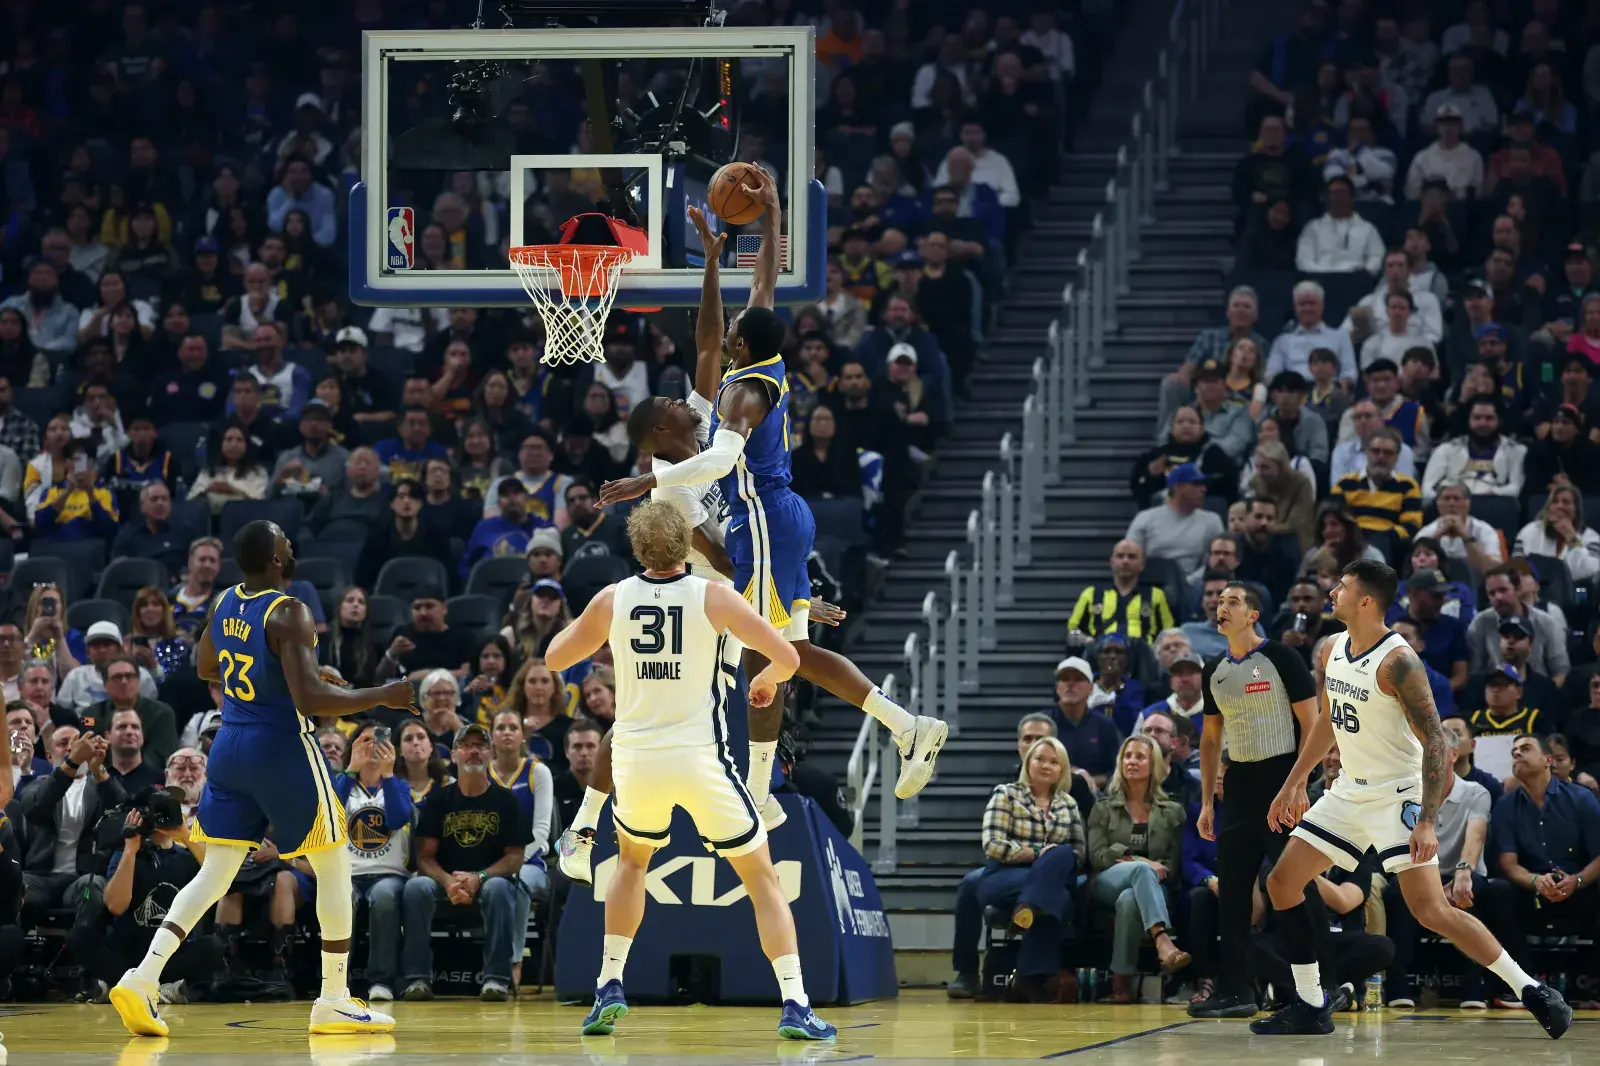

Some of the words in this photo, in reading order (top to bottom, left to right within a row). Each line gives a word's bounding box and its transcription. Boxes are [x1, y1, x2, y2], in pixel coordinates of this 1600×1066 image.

[390, 255, 404, 266] NBA
[223, 618, 252, 642] GREEN
[630, 605, 683, 654] 31
[218, 649, 256, 702] 23
[636, 661, 681, 680] LANDALE
[1246, 684, 1270, 692] Emirates
[1326, 676, 1369, 702] MEMPHIS
[1331, 699, 1360, 733] 46
[368, 814, 383, 827] 30
[436, 970, 473, 984] ASE
